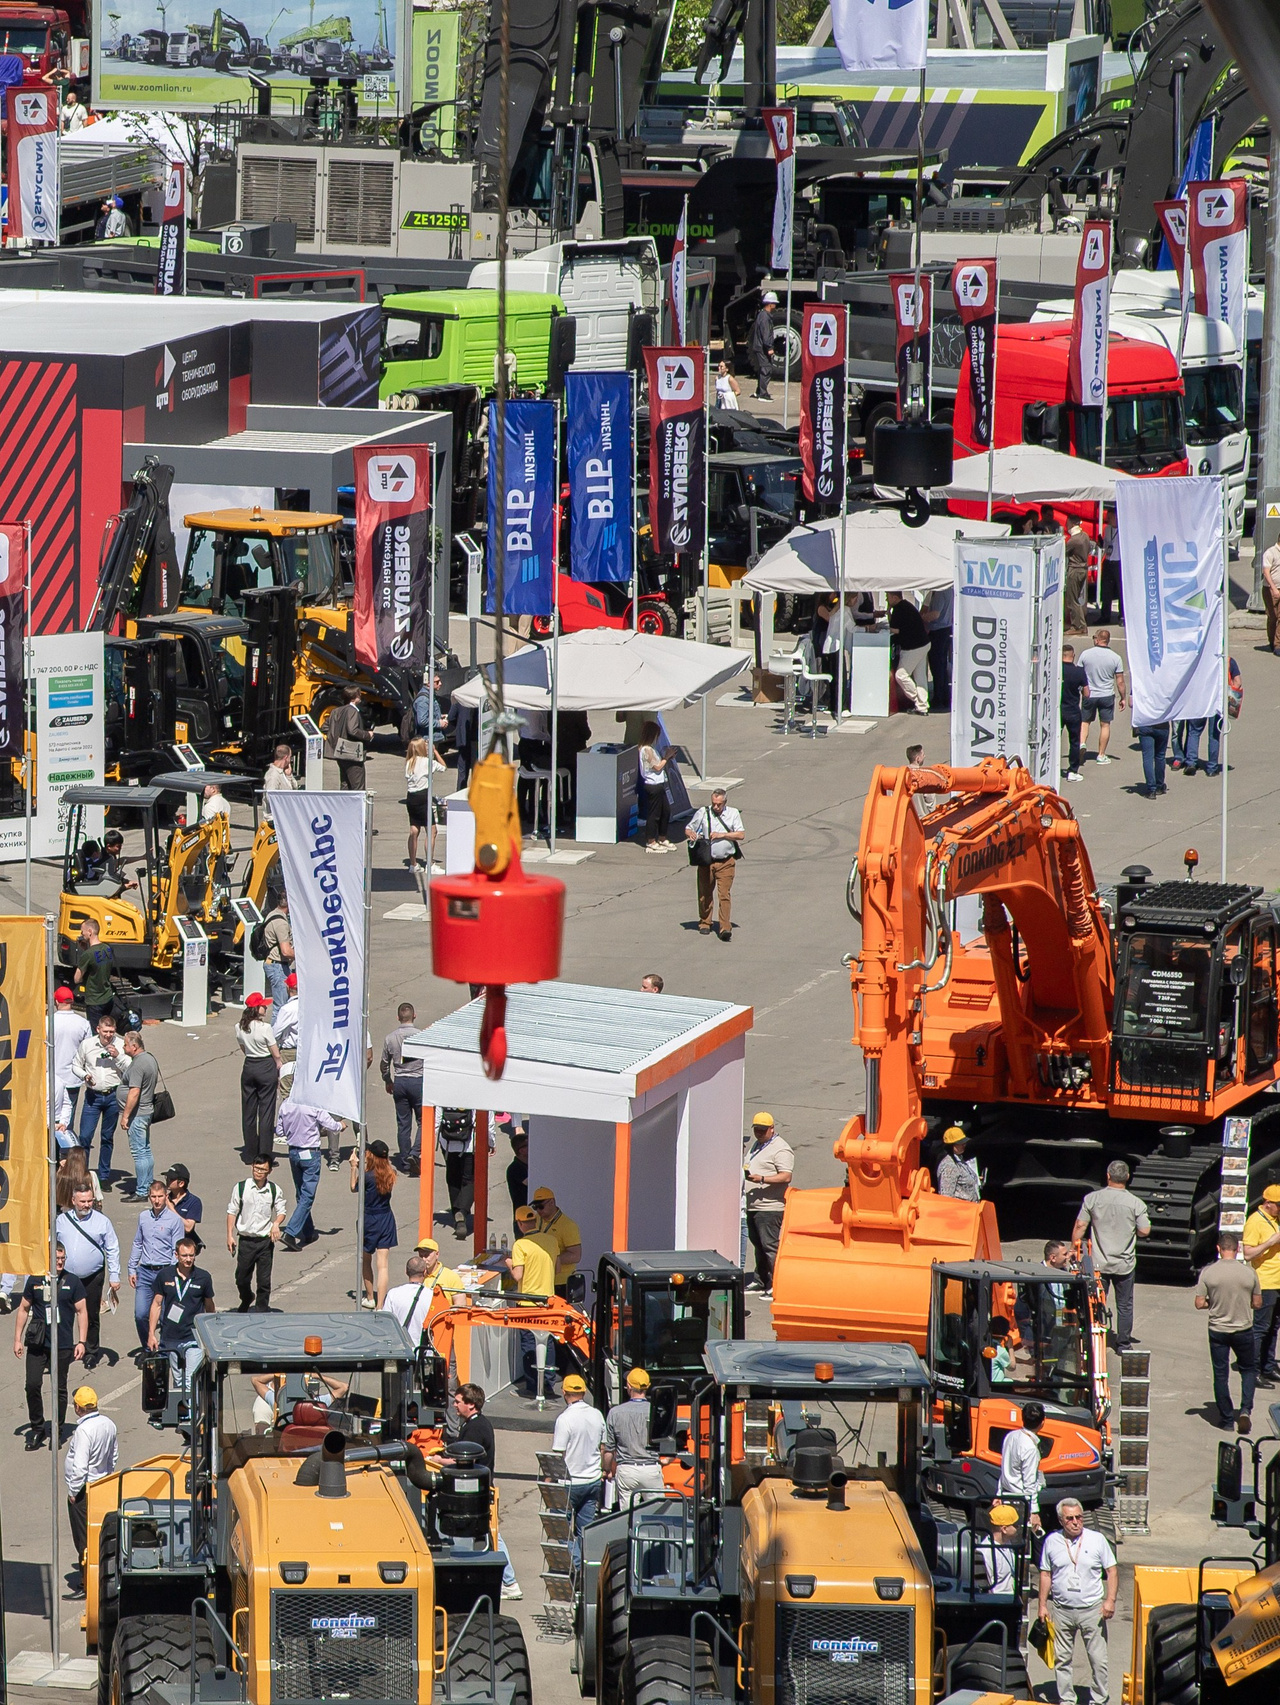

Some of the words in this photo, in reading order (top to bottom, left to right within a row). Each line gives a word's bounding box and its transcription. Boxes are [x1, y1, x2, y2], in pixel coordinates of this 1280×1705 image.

[113, 83, 192, 93] www.zoomlion.ru
[413, 213, 467, 228] ZE1250G
[626, 222, 714, 237] ZOOMON
[160, 562, 168, 608] ZAUBERG
[967, 588, 1017, 599] ТРАНСМЕХСЕРВИС
[84, 663, 99, 672] НДС
[998, 618, 1008, 717] СТРОИТЕЛЬНАЯ
[62, 715, 88, 723] ZAUBERG
[998, 720, 1007, 754] ТЕХН
[49, 769, 94, 782] Надежный
[1151, 970, 1183, 979] CDM6550
